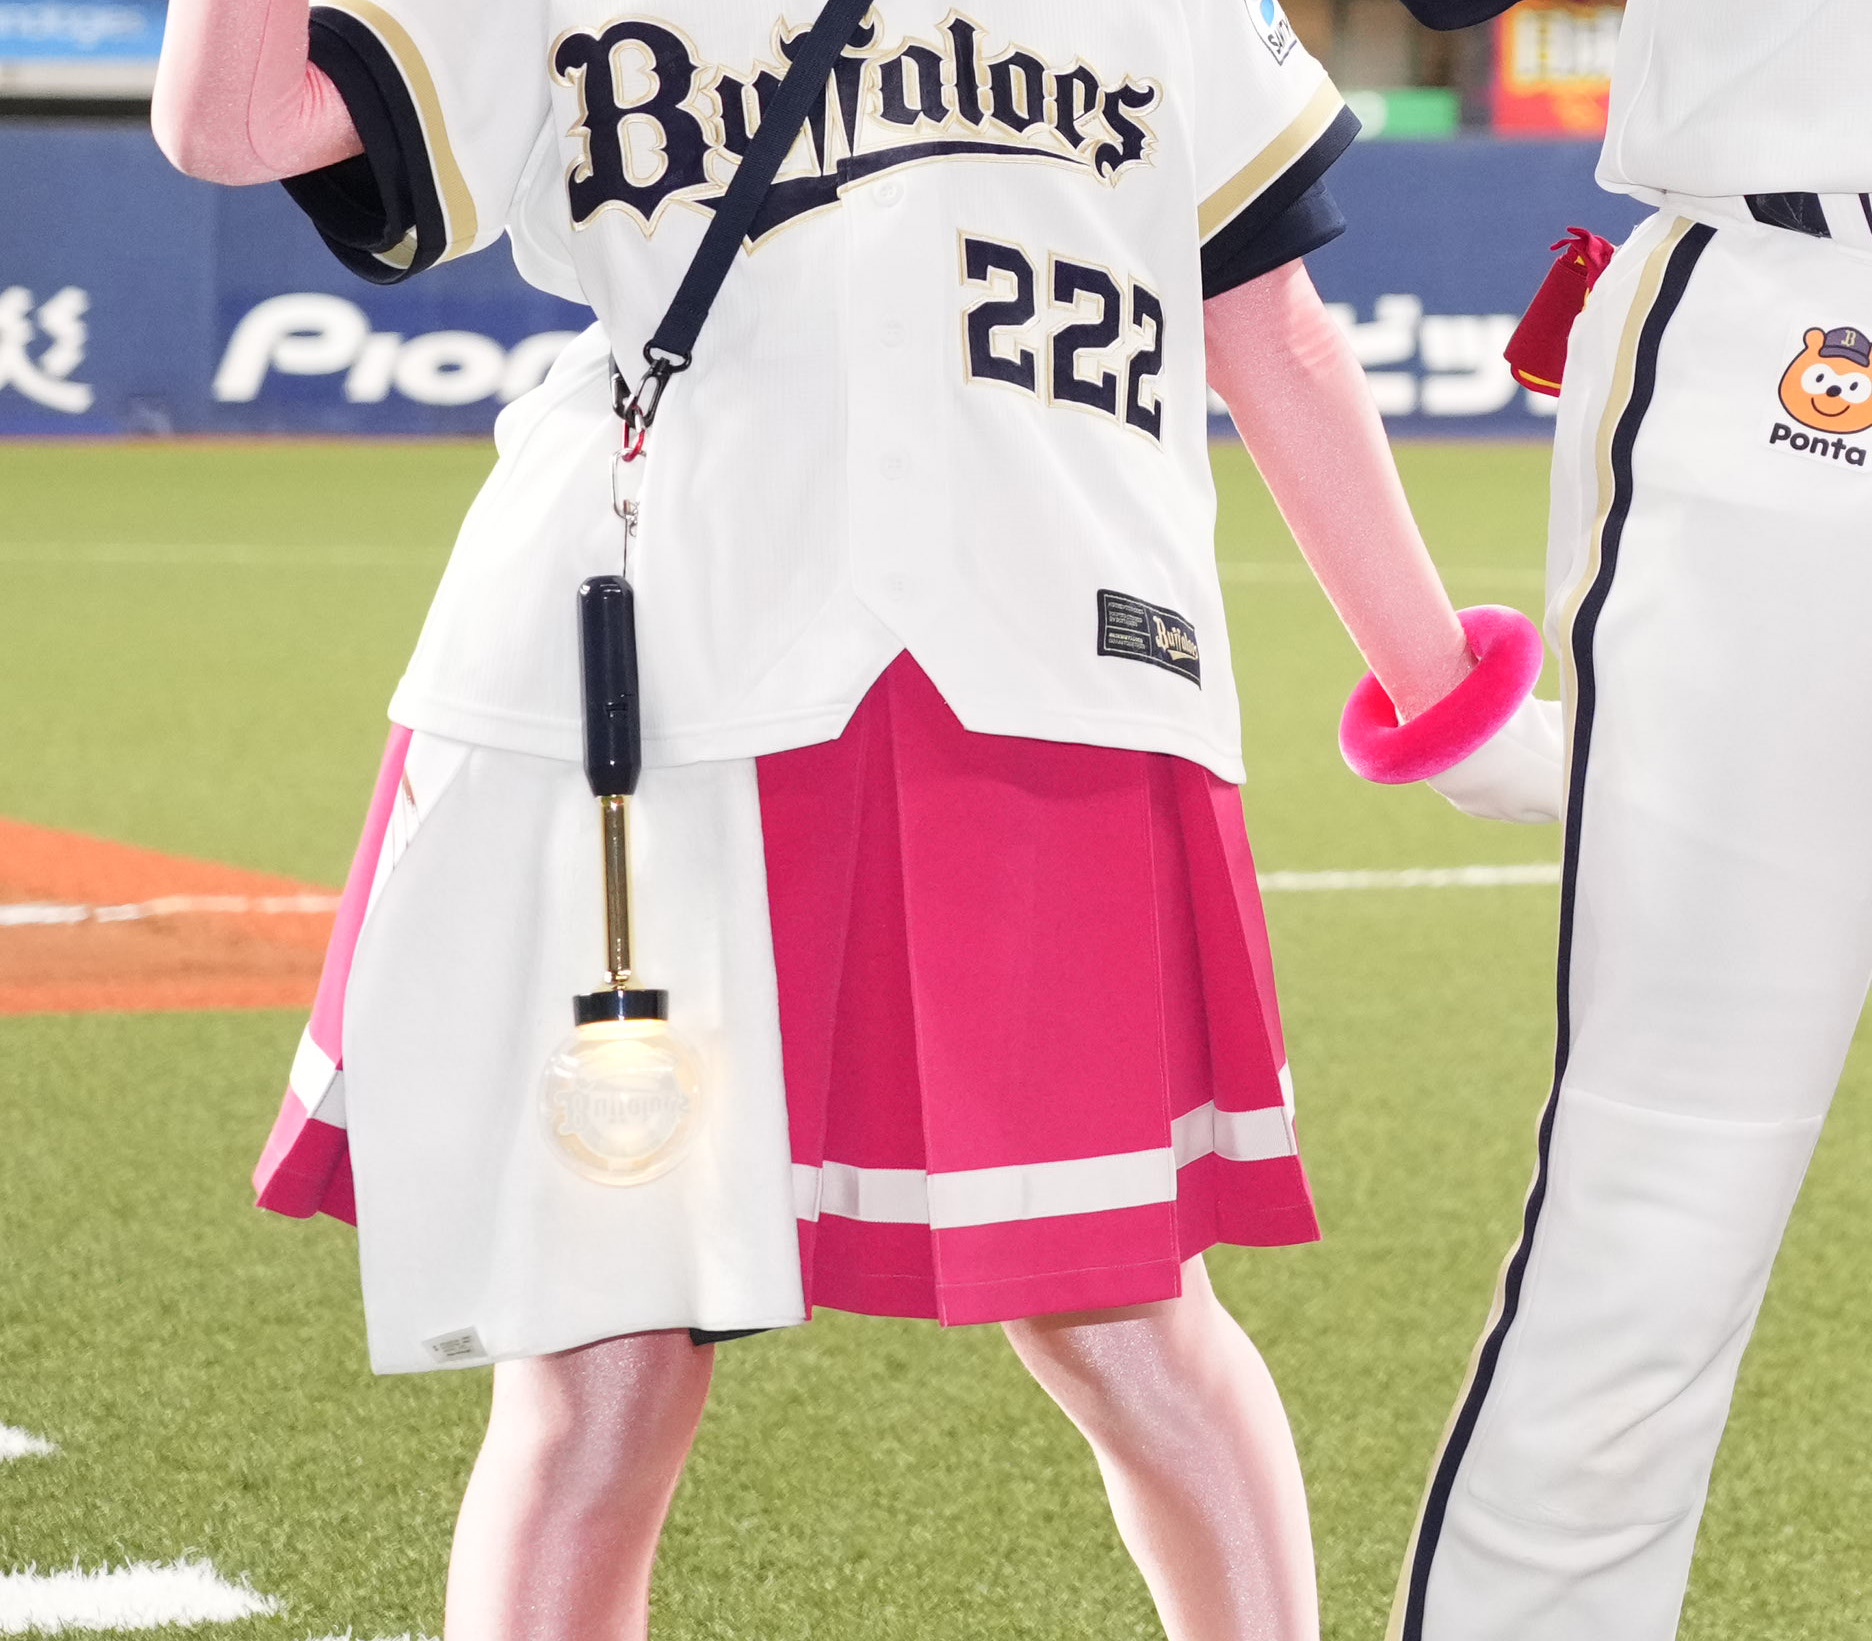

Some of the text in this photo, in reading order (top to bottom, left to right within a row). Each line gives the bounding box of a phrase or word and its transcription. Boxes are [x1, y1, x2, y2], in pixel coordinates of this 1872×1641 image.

[956, 227, 1165, 453] 222
[1841, 329, 1857, 347] B
[1769, 422, 1867, 467] Ponta
